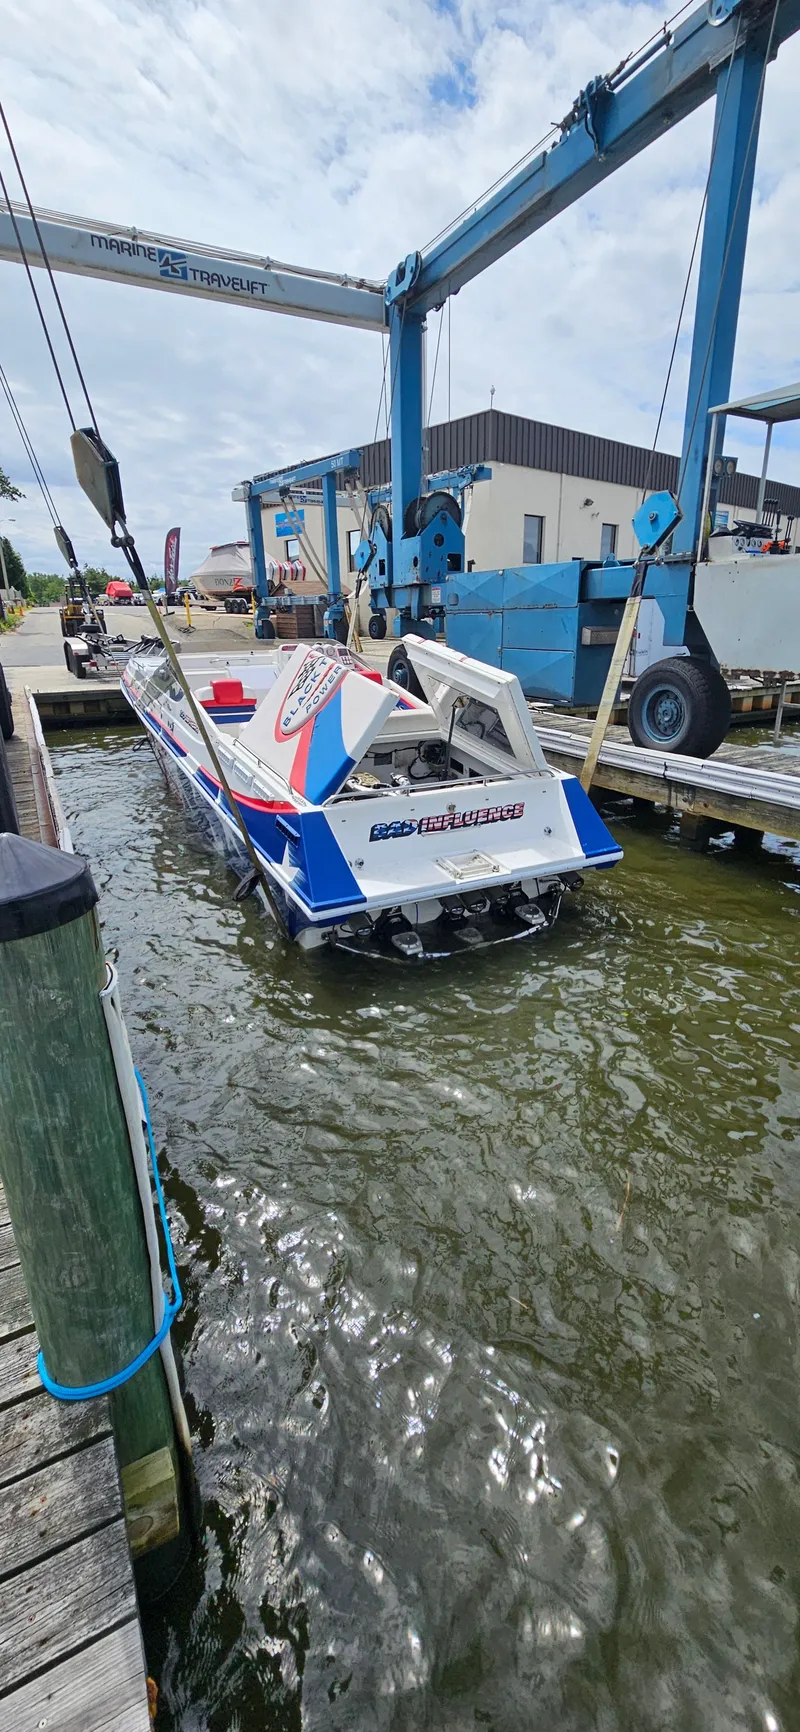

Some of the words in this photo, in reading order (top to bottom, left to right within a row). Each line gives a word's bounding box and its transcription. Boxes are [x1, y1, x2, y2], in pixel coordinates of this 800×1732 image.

[90, 234, 157, 262] MARINE
[189, 268, 268, 294] TRAVELIFT
[282, 671, 321, 727] BLACK
[305, 665, 342, 713] POWER
[369, 819, 418, 842] BAD
[417, 802, 525, 834] INFLUENCE
